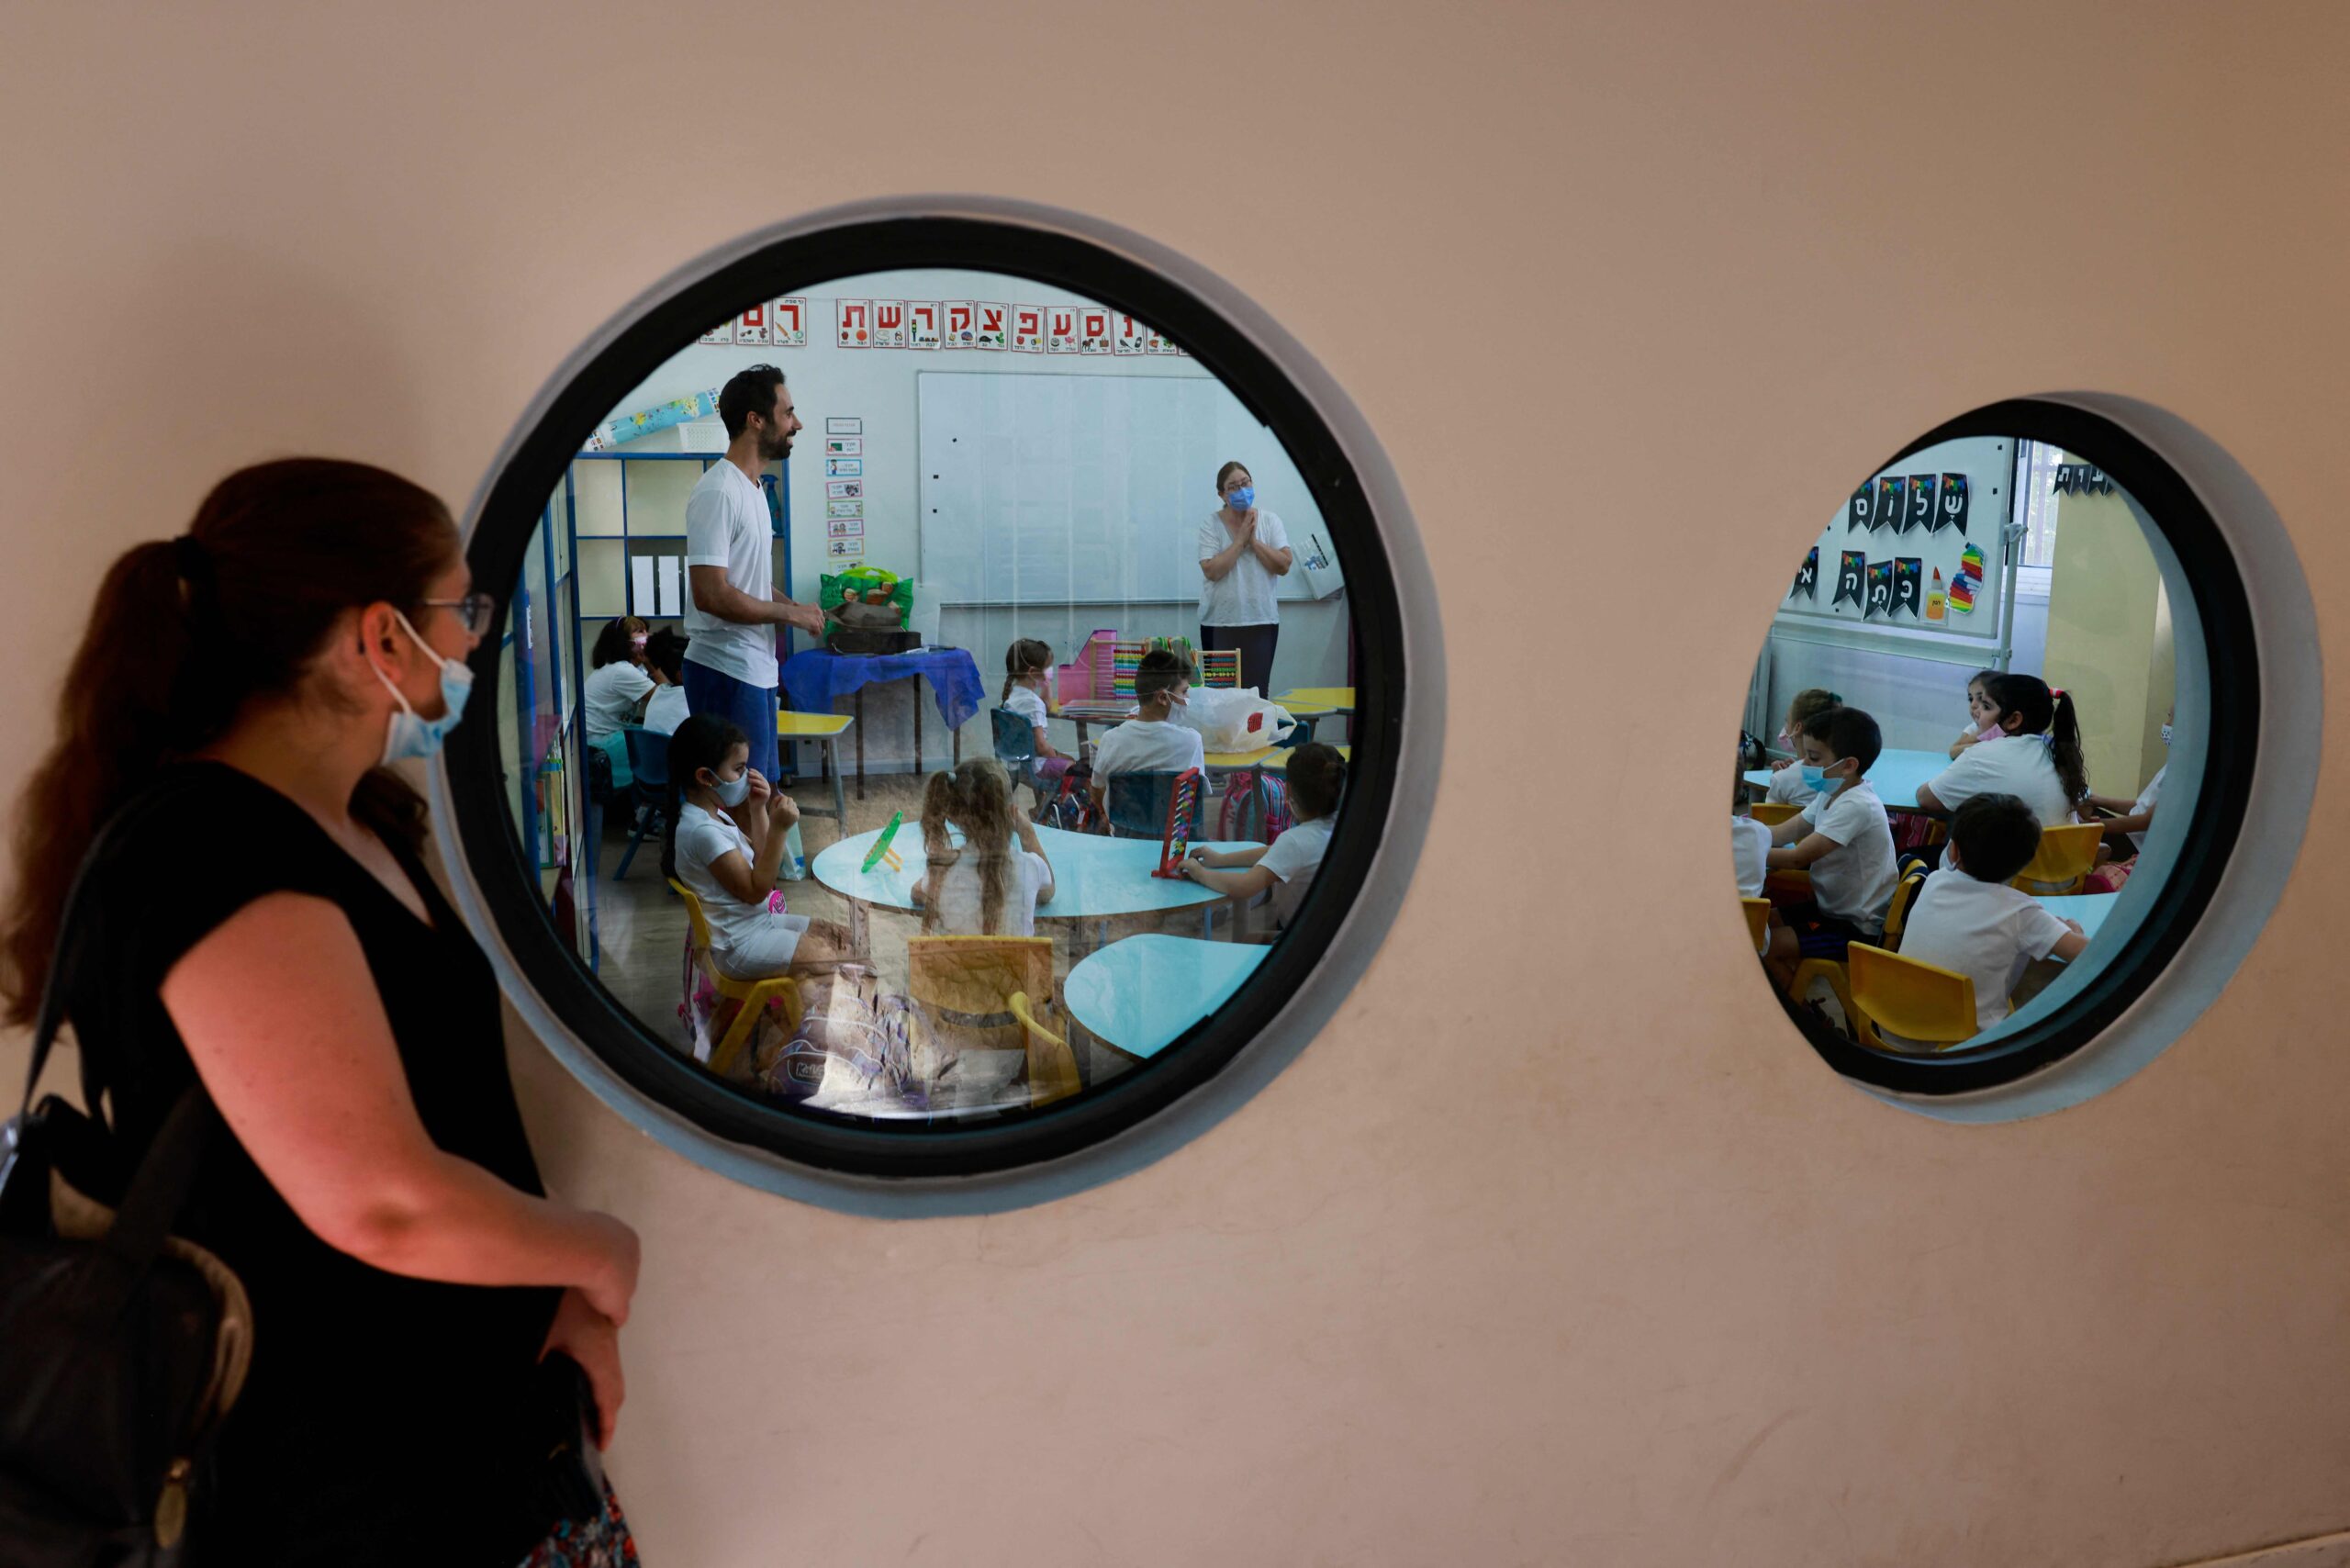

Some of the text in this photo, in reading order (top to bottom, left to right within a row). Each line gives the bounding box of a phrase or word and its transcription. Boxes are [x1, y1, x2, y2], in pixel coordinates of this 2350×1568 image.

[843, 306, 865, 328] ת
[878, 306, 901, 328] ש
[915, 308, 933, 330] ר
[950, 308, 970, 332] ק
[983, 308, 1002, 331] צ
[1019, 312, 1038, 334] פ
[1053, 314, 1071, 335] ע
